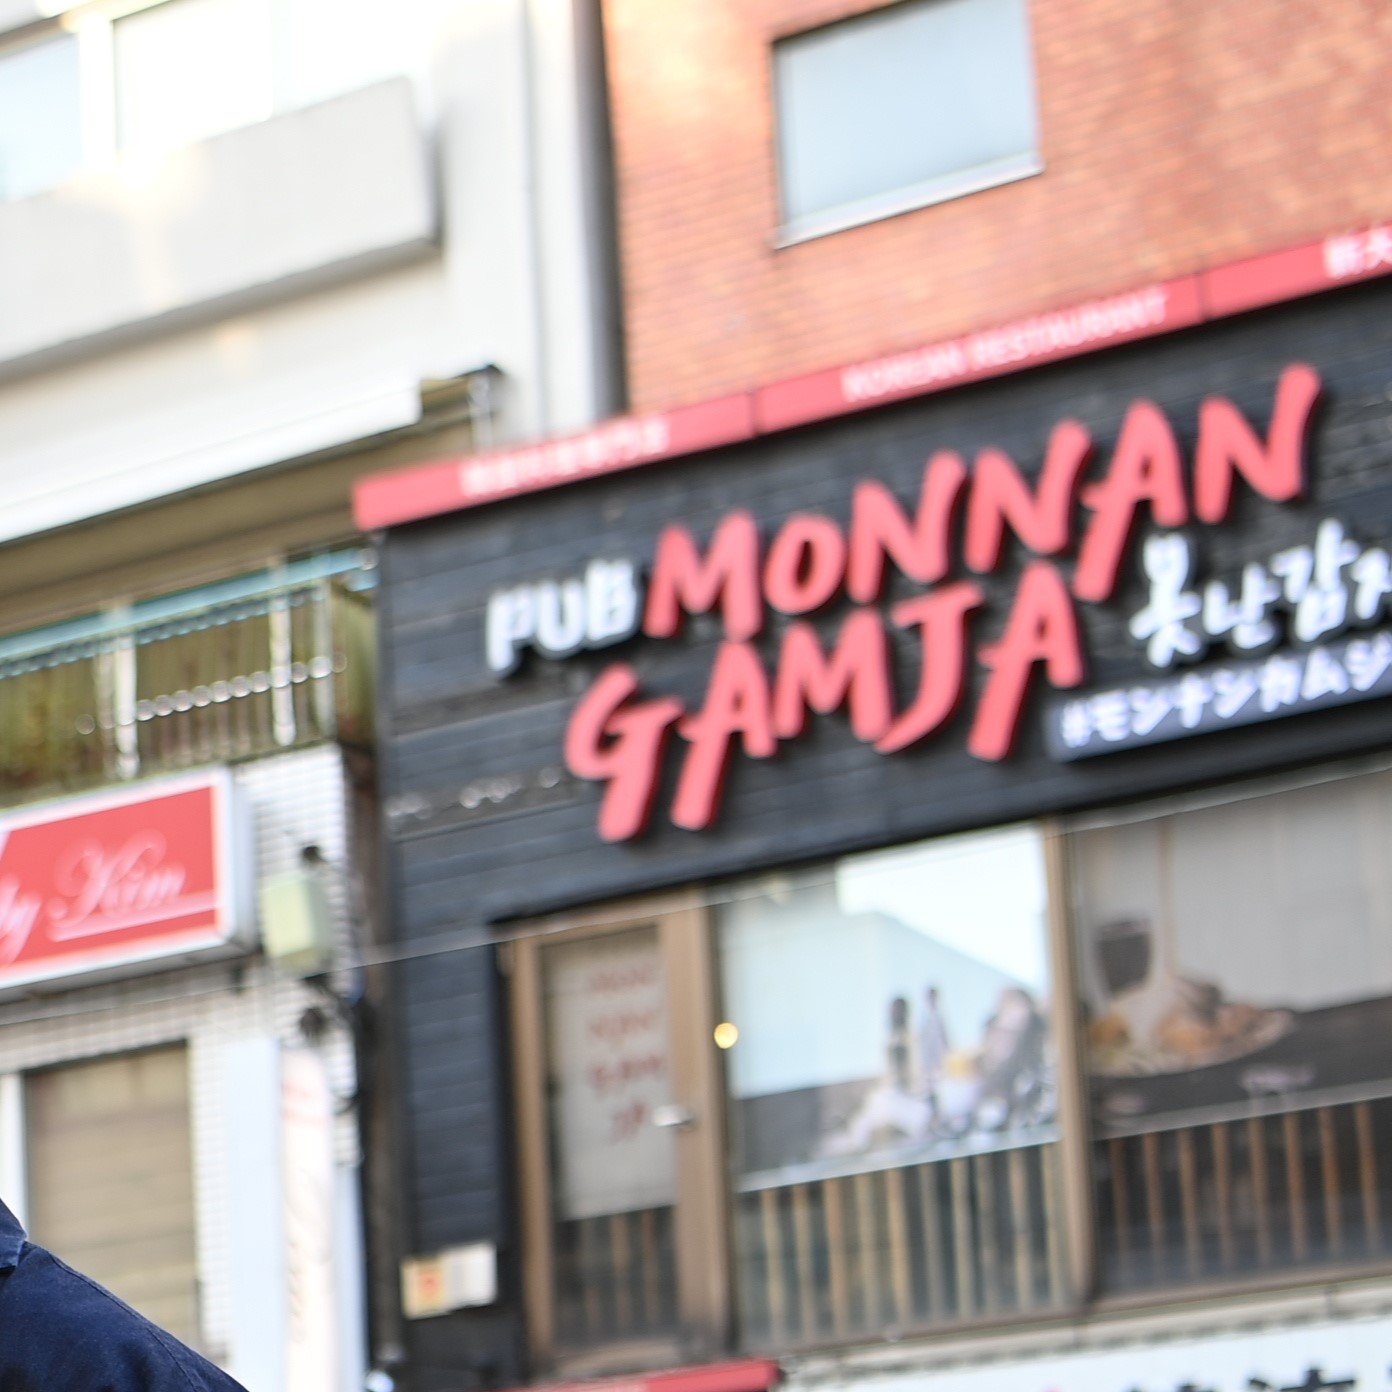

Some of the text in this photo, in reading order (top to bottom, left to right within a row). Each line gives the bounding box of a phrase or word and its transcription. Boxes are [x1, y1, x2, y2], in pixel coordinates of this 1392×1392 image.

[486, 364, 1321, 673] PUB MONNAN
[565, 560, 1083, 843] GAMJA
[48, 828, 188, 930] Kim
